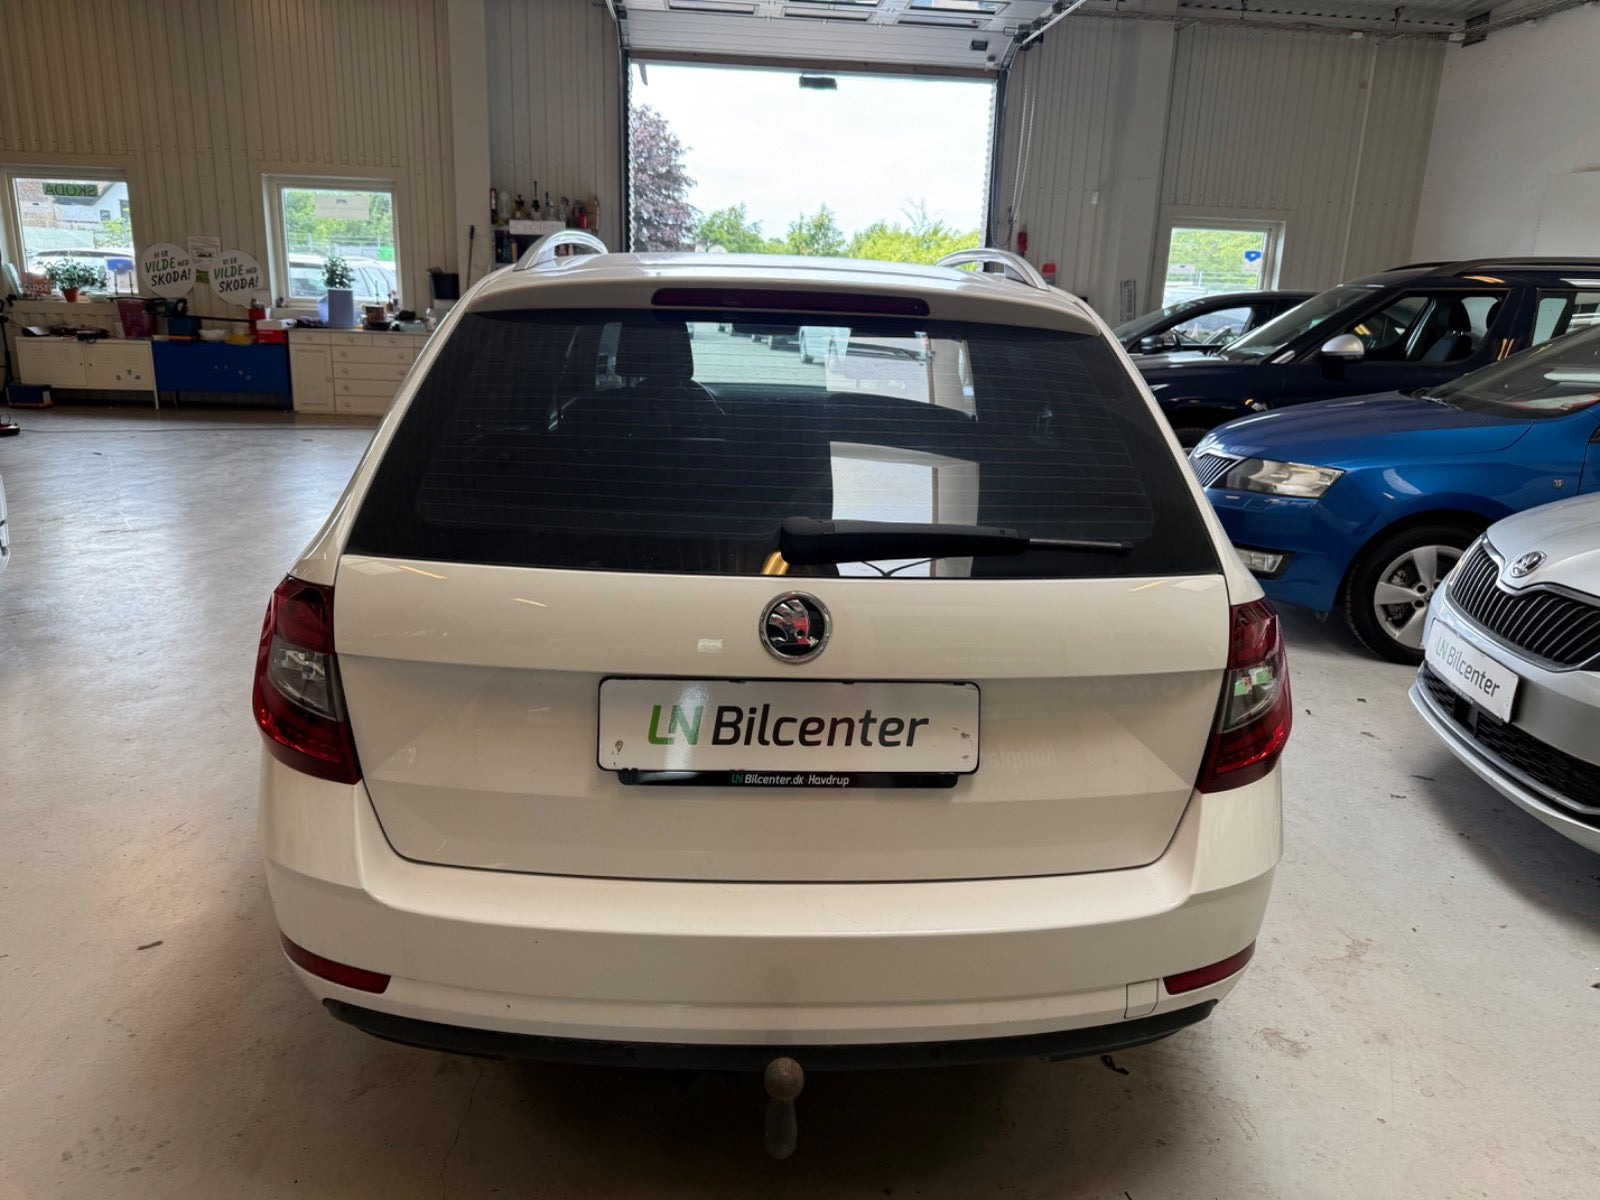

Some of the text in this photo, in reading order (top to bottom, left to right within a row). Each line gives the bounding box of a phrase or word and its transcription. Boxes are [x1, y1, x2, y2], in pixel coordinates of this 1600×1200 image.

[145, 257, 175, 274] VILDE
[214, 264, 244, 280] VILDE
[151, 268, 191, 287] SKODA!
[219, 276, 259, 293] SKODA!
[1436, 638, 1500, 697] LN Bilcenter
[648, 703, 929, 748] LN Bilcenter
[744, 774, 804, 785] Bilcenter.dk
[808, 774, 850, 788] Havdrup
